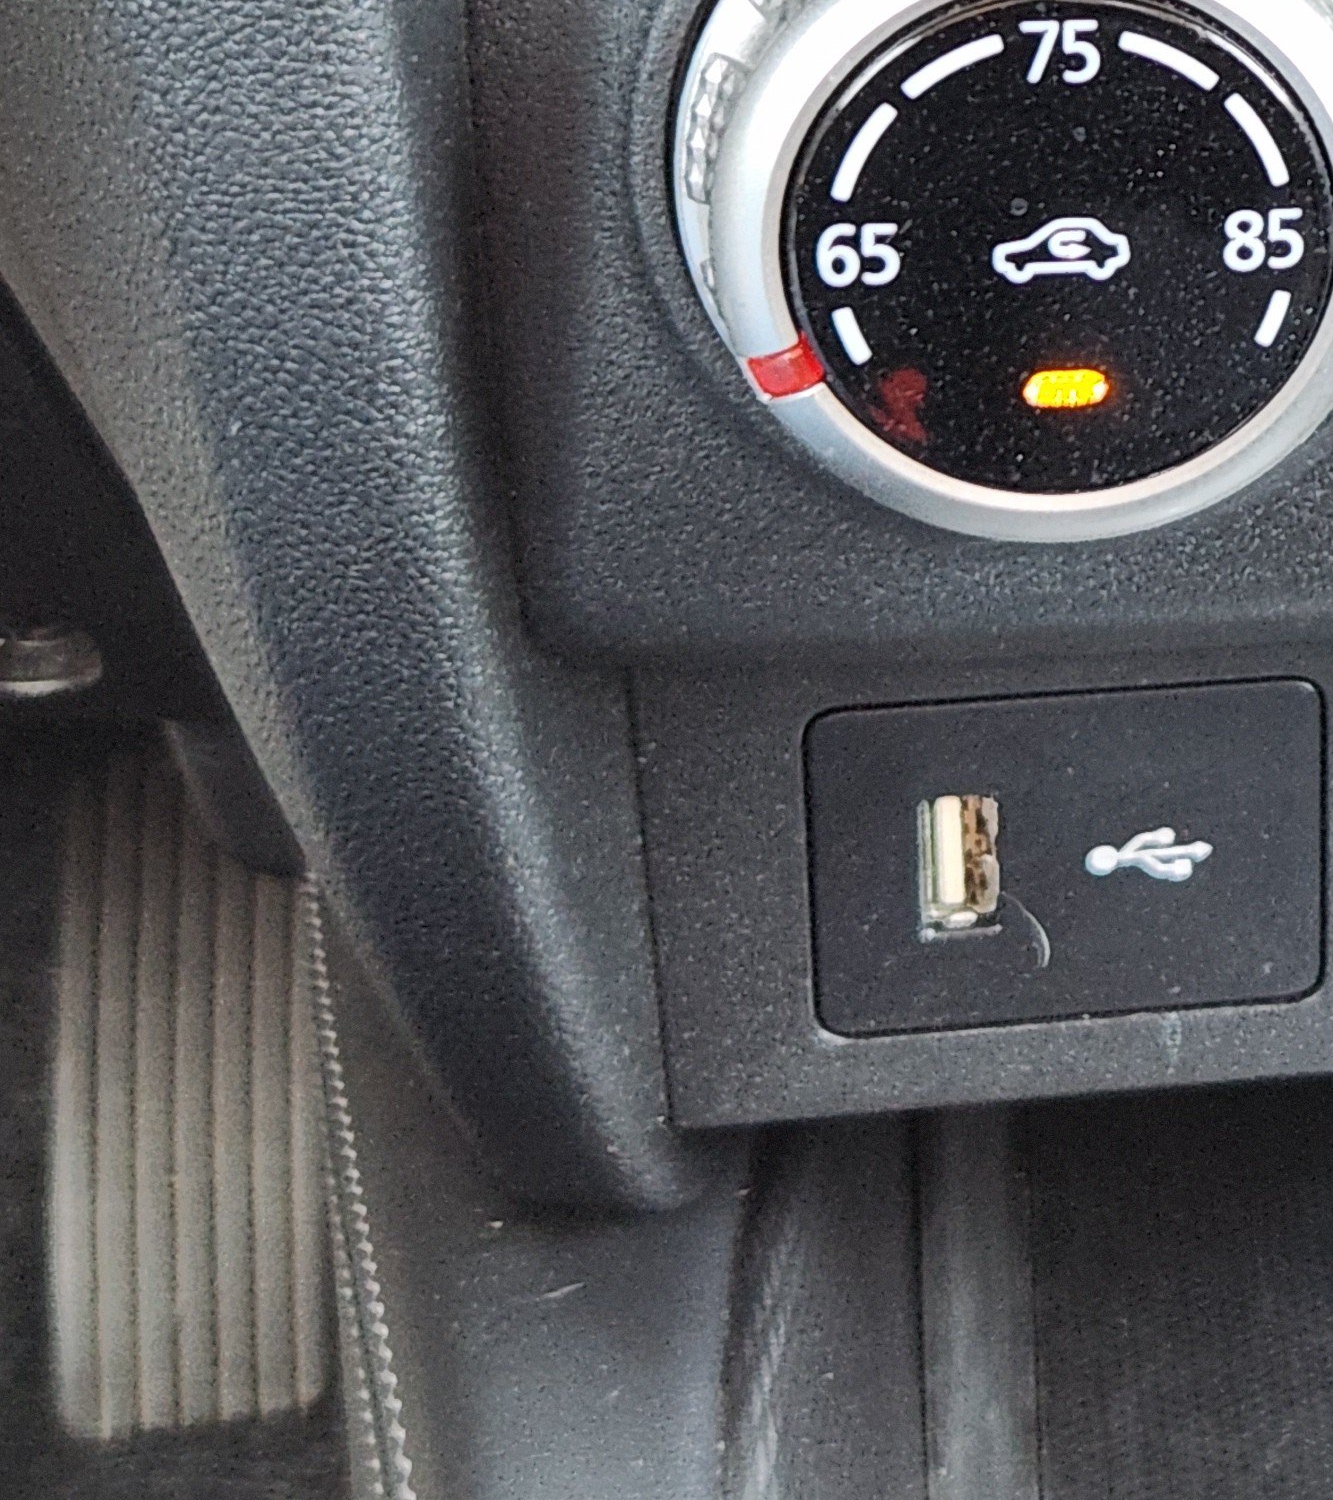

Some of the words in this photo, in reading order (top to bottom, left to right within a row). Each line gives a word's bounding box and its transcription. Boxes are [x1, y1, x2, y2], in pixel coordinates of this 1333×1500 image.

[1018, 18, 1101, 84] 75
[815, 222, 902, 288] 65
[1222, 207, 1304, 273] 85
